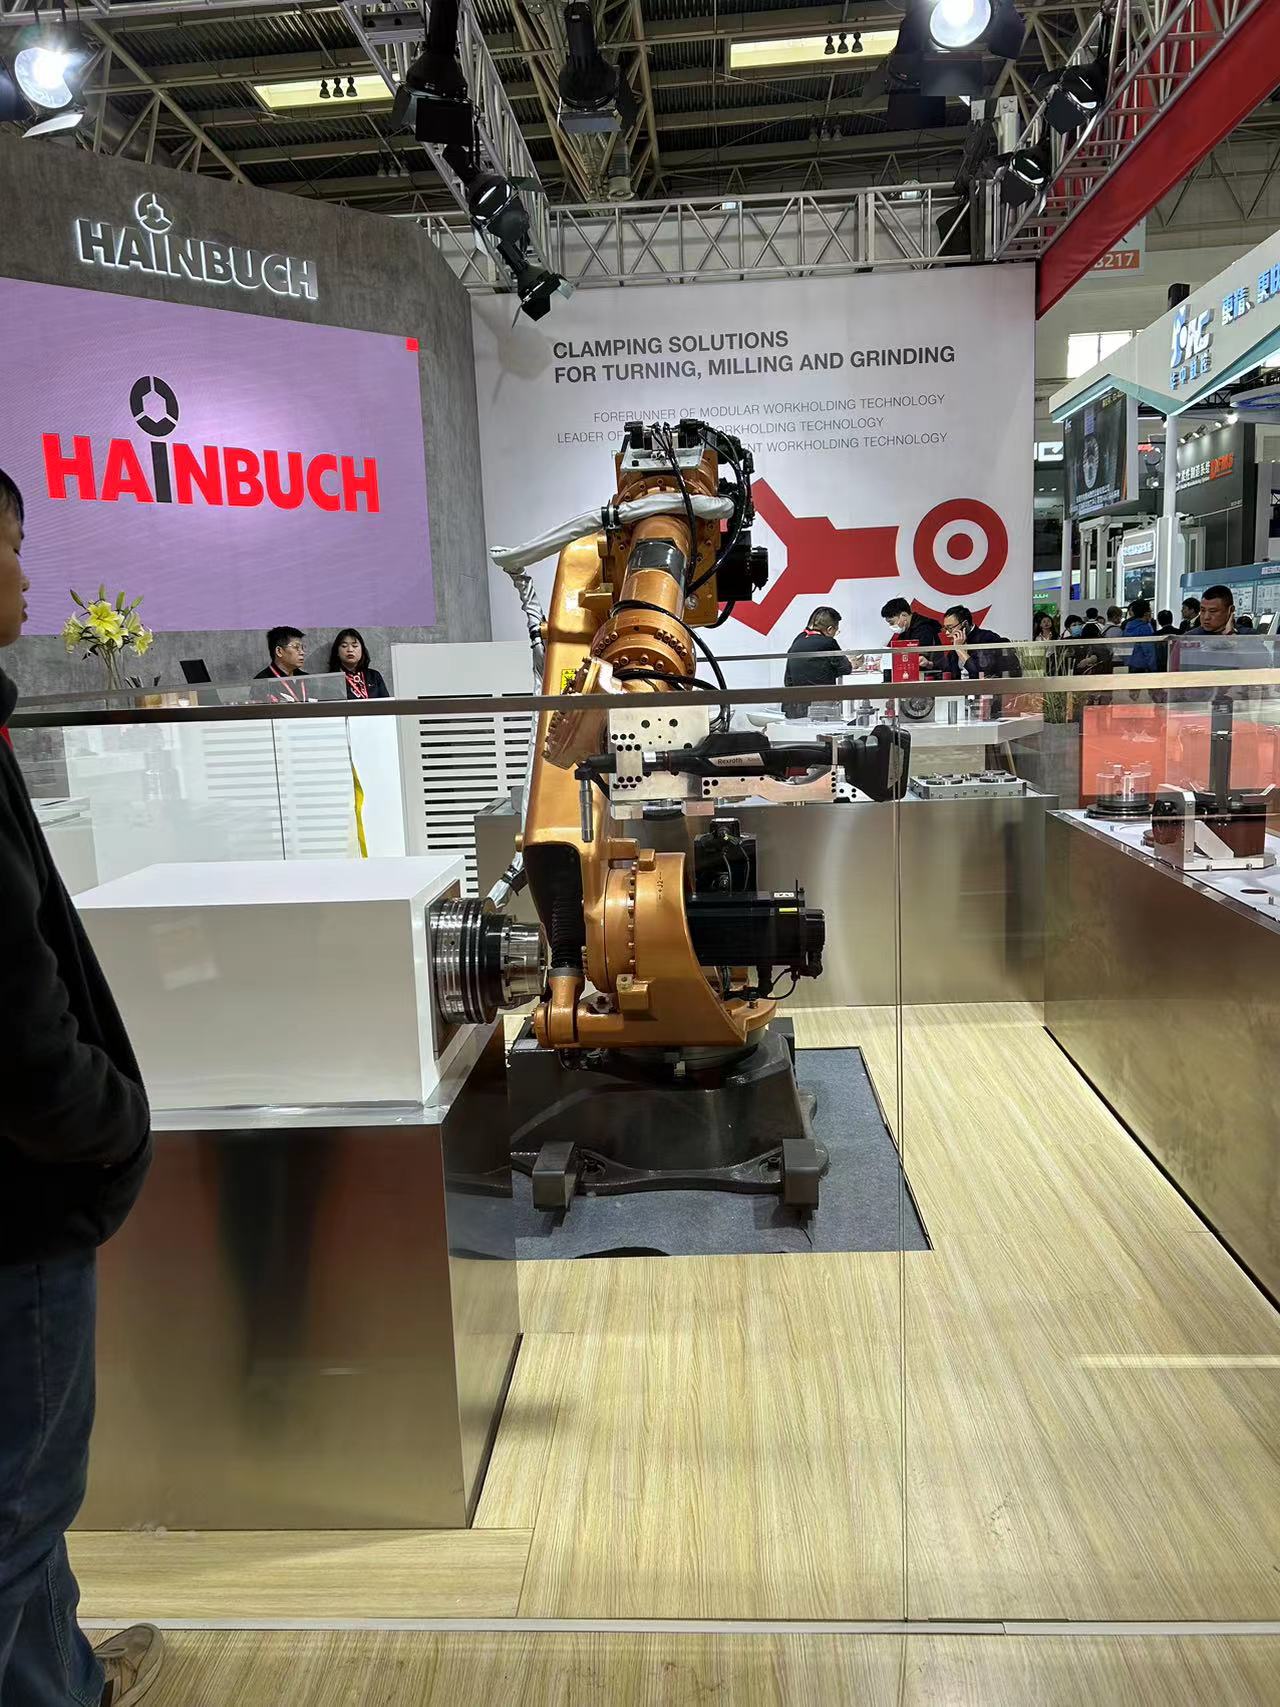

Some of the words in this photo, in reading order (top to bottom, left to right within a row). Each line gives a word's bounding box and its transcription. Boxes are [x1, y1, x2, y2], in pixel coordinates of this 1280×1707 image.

[76, 218, 319, 300] HAINBUCH
[553, 337, 663, 359] CLAMPING
[669, 330, 789, 353] SOLUTIONS
[555, 365, 597, 383] FOR
[602, 360, 702, 381] TURNING,
[708, 355, 793, 376] MILLING
[800, 352, 844, 371] AND
[850, 345, 955, 368] GRINDING
[594, 408, 676, 423] FORERUNNER
[680, 408, 696, 420] OF
[700, 404, 760, 418] MODULAR
[763, 399, 856, 414] WORKHOLDING
[860, 393, 946, 409] TECHNOLOGY
[557, 432, 604, 444] LEADER
[608, 430, 624, 442] OF
[716, 421, 796, 436] ORKHOLDING
[801, 416, 884, 432] TECHNOLOGY
[767, 437, 859, 452] WORKHOLDING
[863, 432, 948, 448] TECHNOLOGY
[42, 432, 380, 512] HAINBUCH
